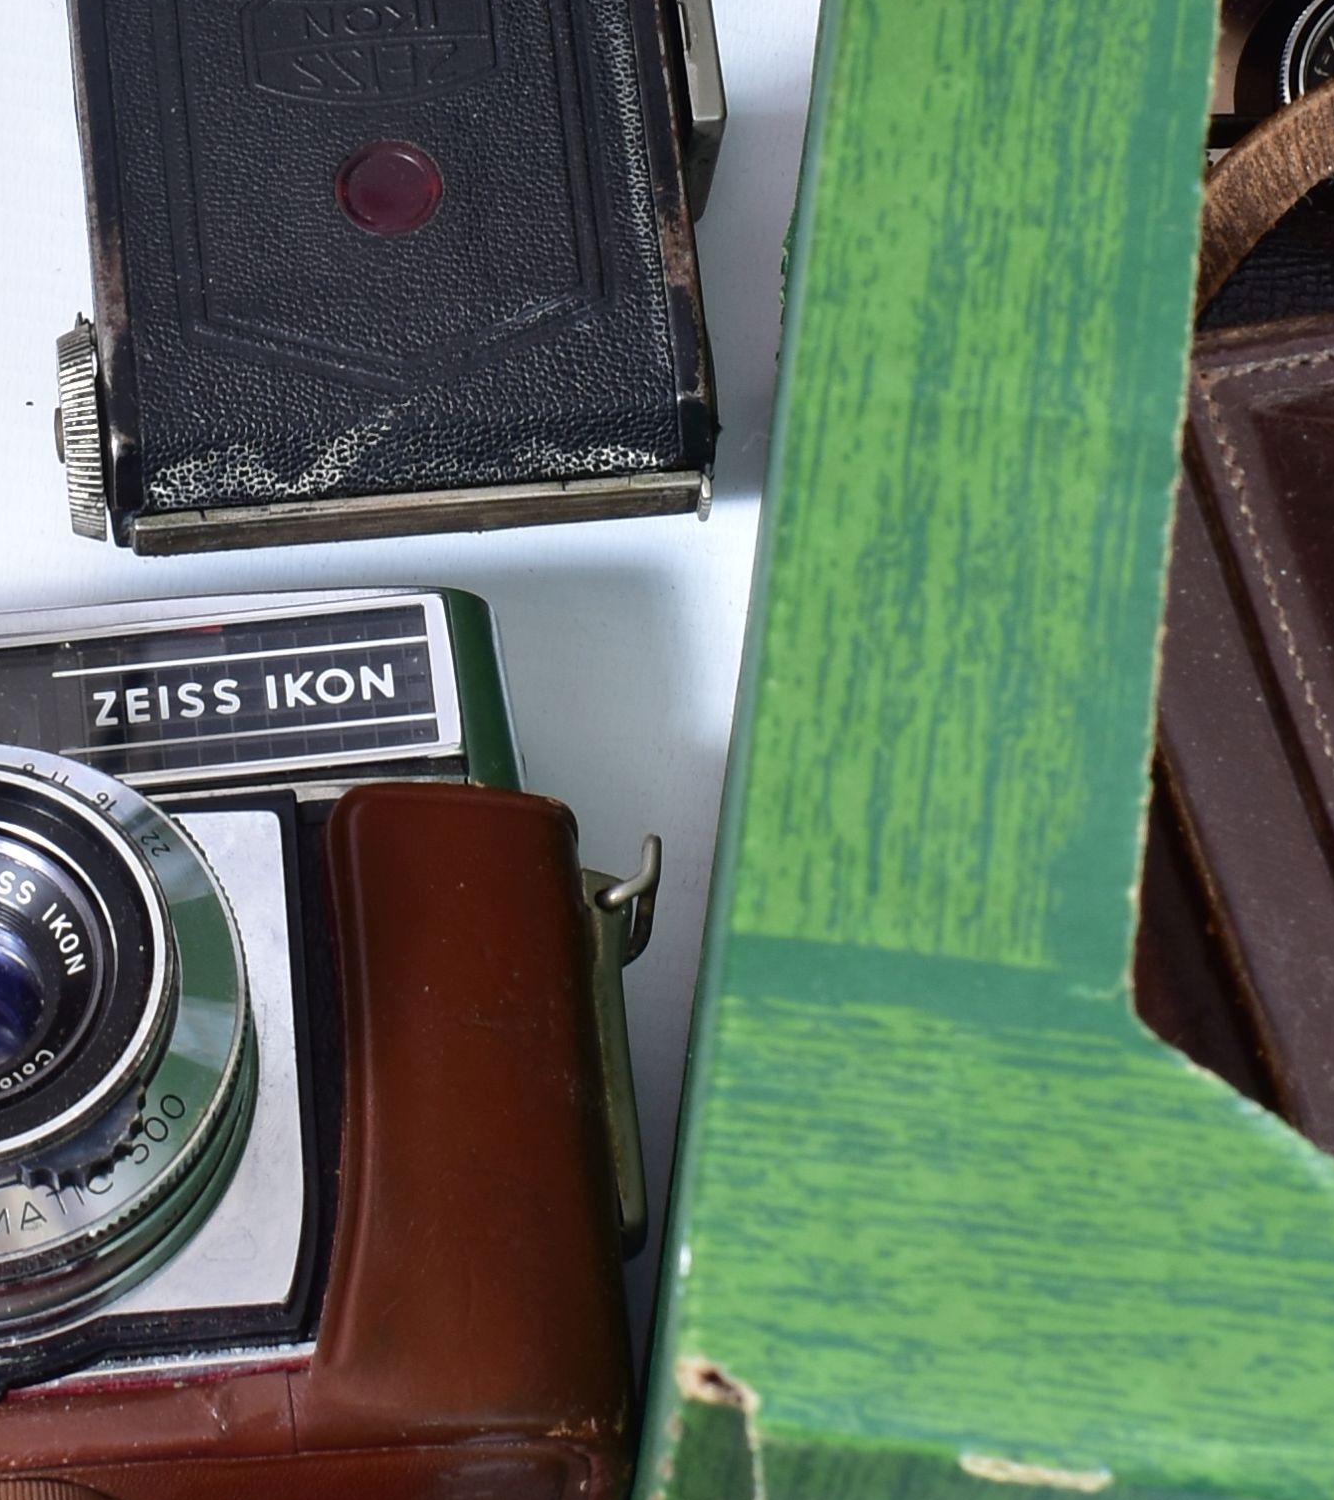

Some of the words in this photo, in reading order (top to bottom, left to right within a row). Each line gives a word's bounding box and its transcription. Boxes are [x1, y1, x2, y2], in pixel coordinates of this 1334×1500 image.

[292, 43, 458, 95] ZEISS
[92, 679, 242, 727] ZEISS
[266, 663, 395, 709] IKON
[139, 830, 172, 857] 22
[42, 902, 87, 976] IKON
